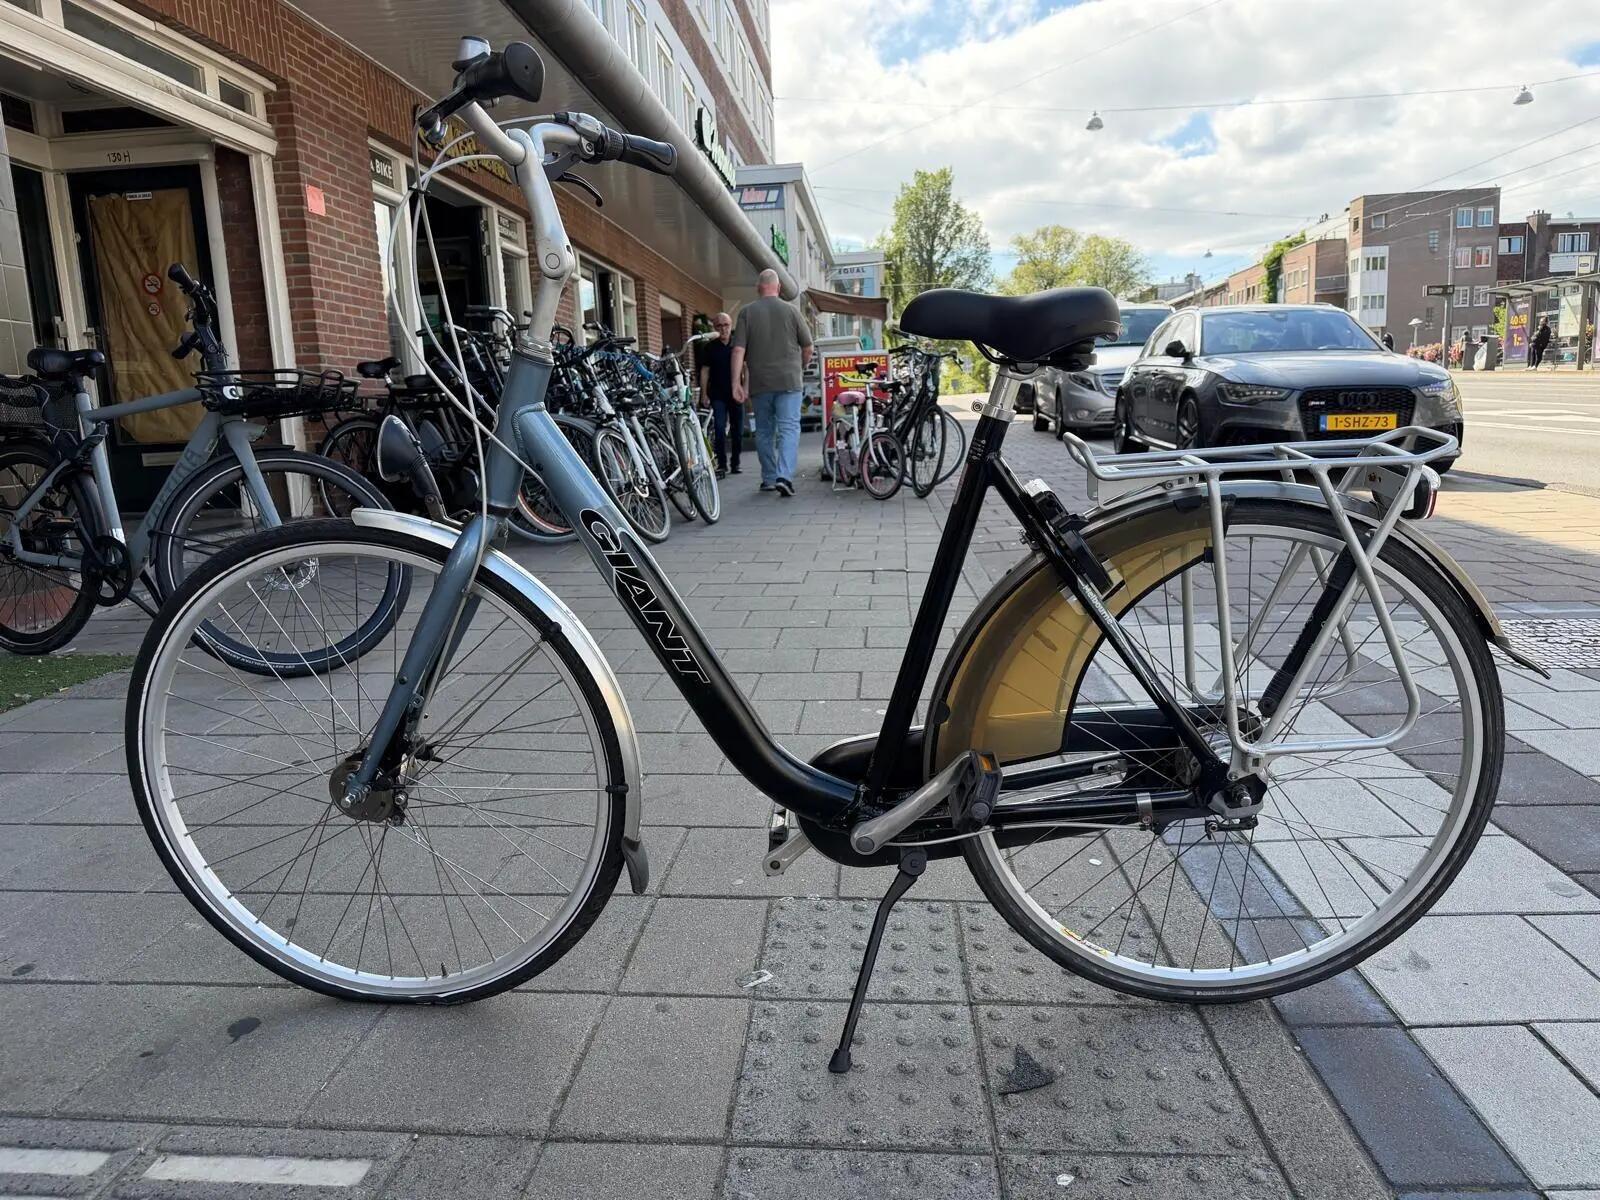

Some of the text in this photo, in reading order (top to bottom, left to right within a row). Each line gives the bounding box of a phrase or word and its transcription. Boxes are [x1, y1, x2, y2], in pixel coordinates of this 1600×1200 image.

[107, 150, 131, 163] 130 H
[375, 159, 393, 180] BIKE
[827, 357, 855, 368] RENT
[1334, 416, 1389, 428] 1-SHZ-73
[579, 508, 711, 684] GIANT
[1082, 584, 1113, 625] Melbourne
